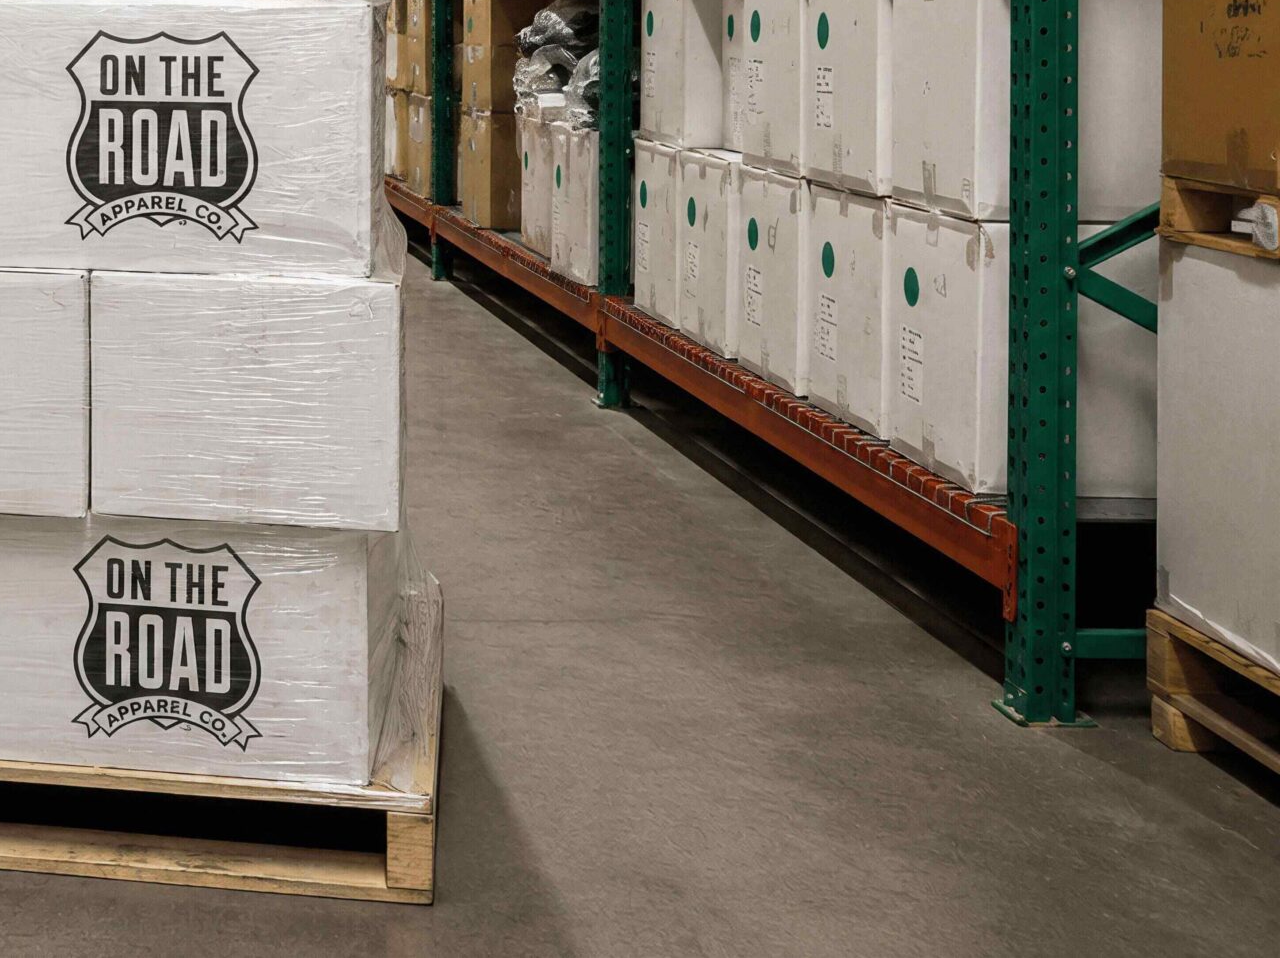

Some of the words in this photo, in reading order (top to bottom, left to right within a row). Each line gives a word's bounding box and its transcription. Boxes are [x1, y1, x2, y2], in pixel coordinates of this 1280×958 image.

[99, 54, 146, 96] ON
[159, 55, 225, 97] THE
[98, 108, 228, 188] ROAD
[99, 195, 188, 227] APPAREL
[106, 557, 152, 601] ON
[164, 561, 229, 607] THE
[105, 610, 231, 694] ROAD
[106, 698, 192, 729] APPAREL
[198, 710, 228, 739] CO.
